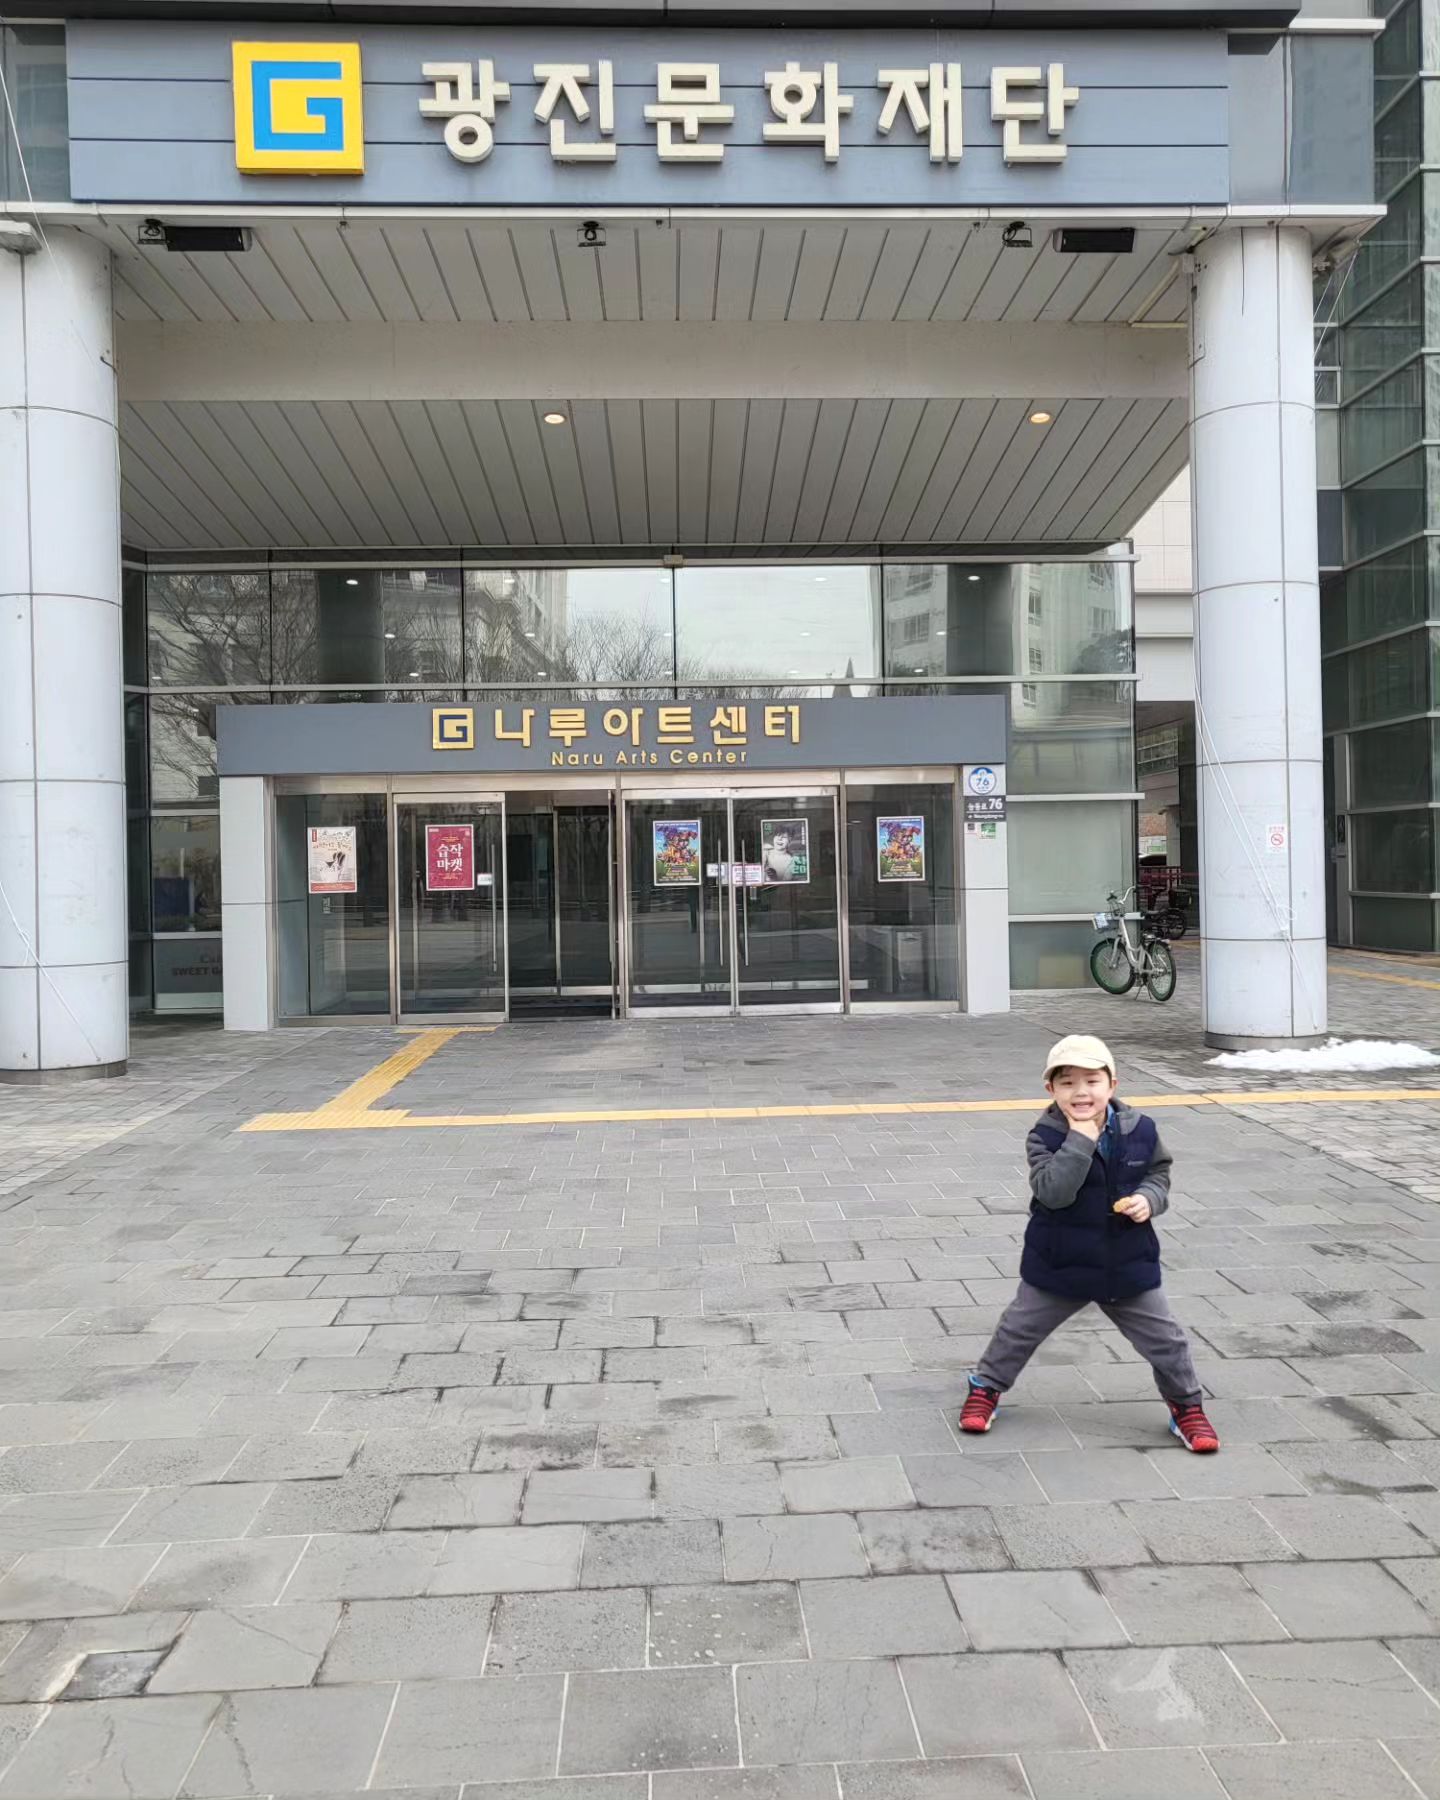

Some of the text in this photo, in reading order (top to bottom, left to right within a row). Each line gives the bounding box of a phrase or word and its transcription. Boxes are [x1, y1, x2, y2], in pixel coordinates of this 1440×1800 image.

[418, 59, 1080, 163] 광진문화재단
[494, 706, 801, 748] 나루아트센터
[551, 749, 747, 765] Naru Arts Center
[988, 798, 1003, 810] 76
[437, 843, 463, 857] 습작
[436, 857, 463, 871] 마켓
